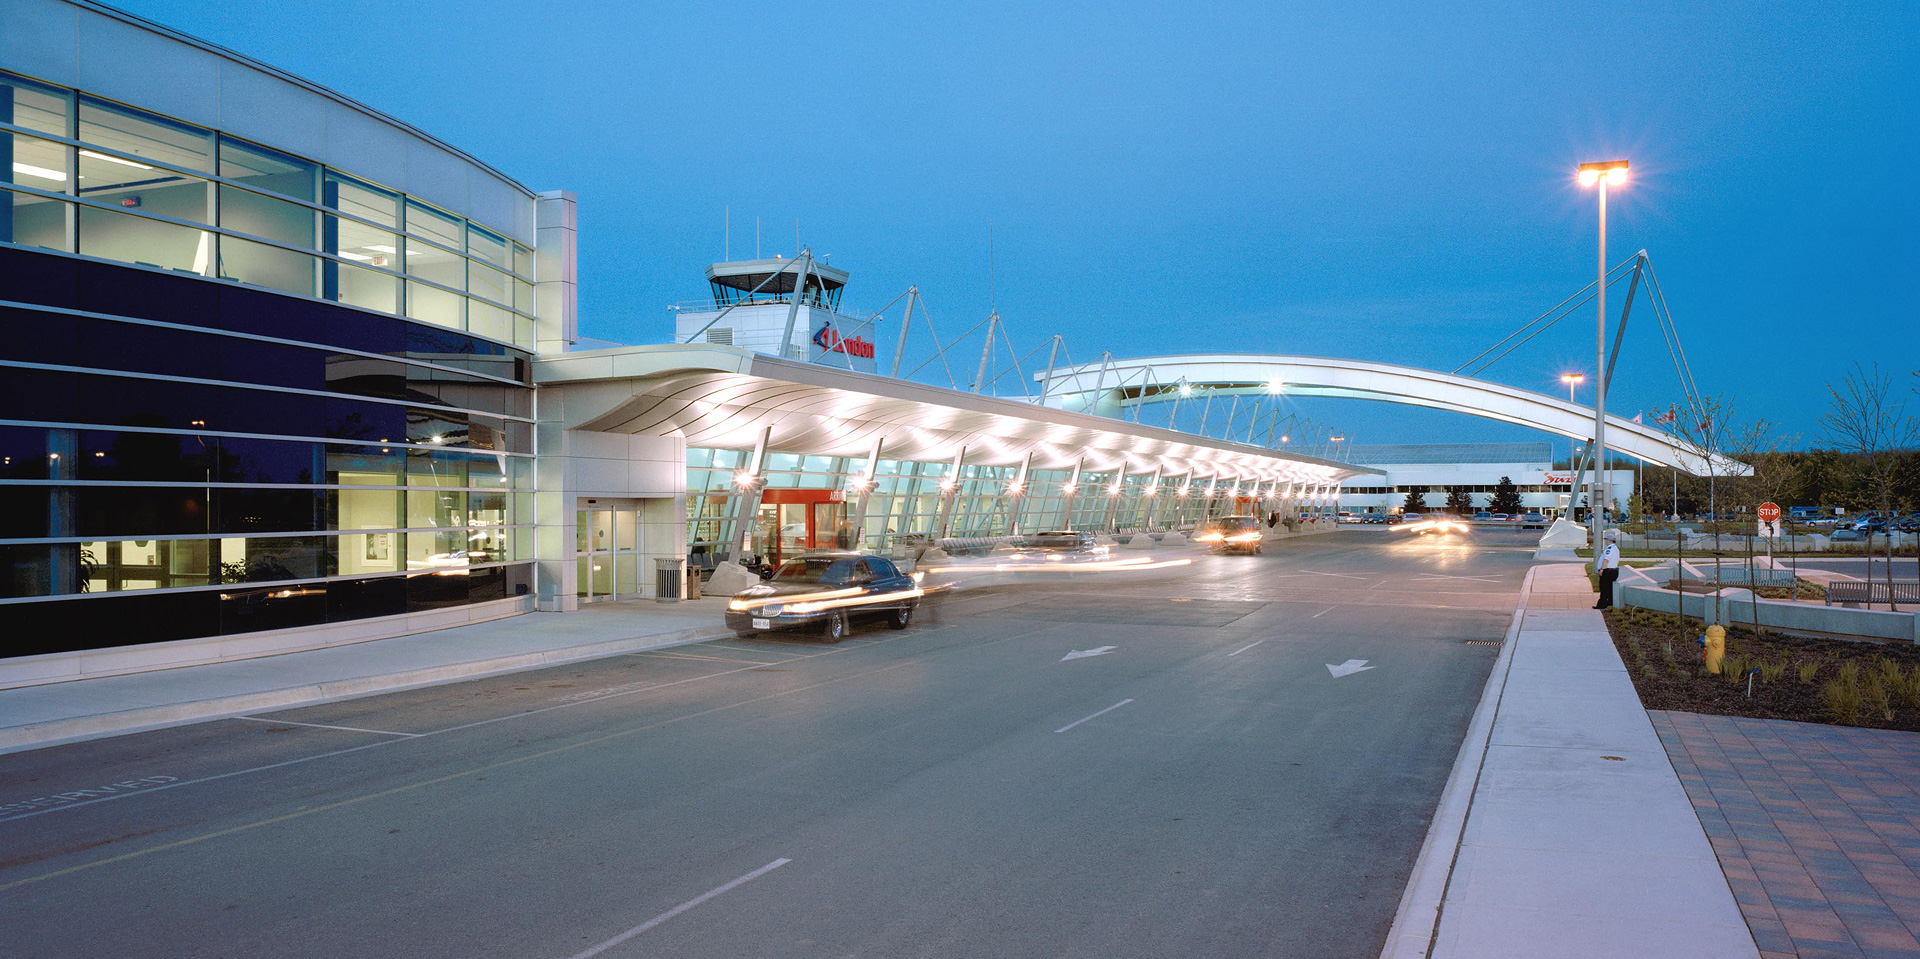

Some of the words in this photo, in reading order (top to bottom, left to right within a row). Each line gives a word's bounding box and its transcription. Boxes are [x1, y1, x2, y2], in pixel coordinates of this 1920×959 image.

[832, 329, 875, 359] London
[1760, 508, 1779, 516] STOP
[0, 775, 179, 815] SERVED
